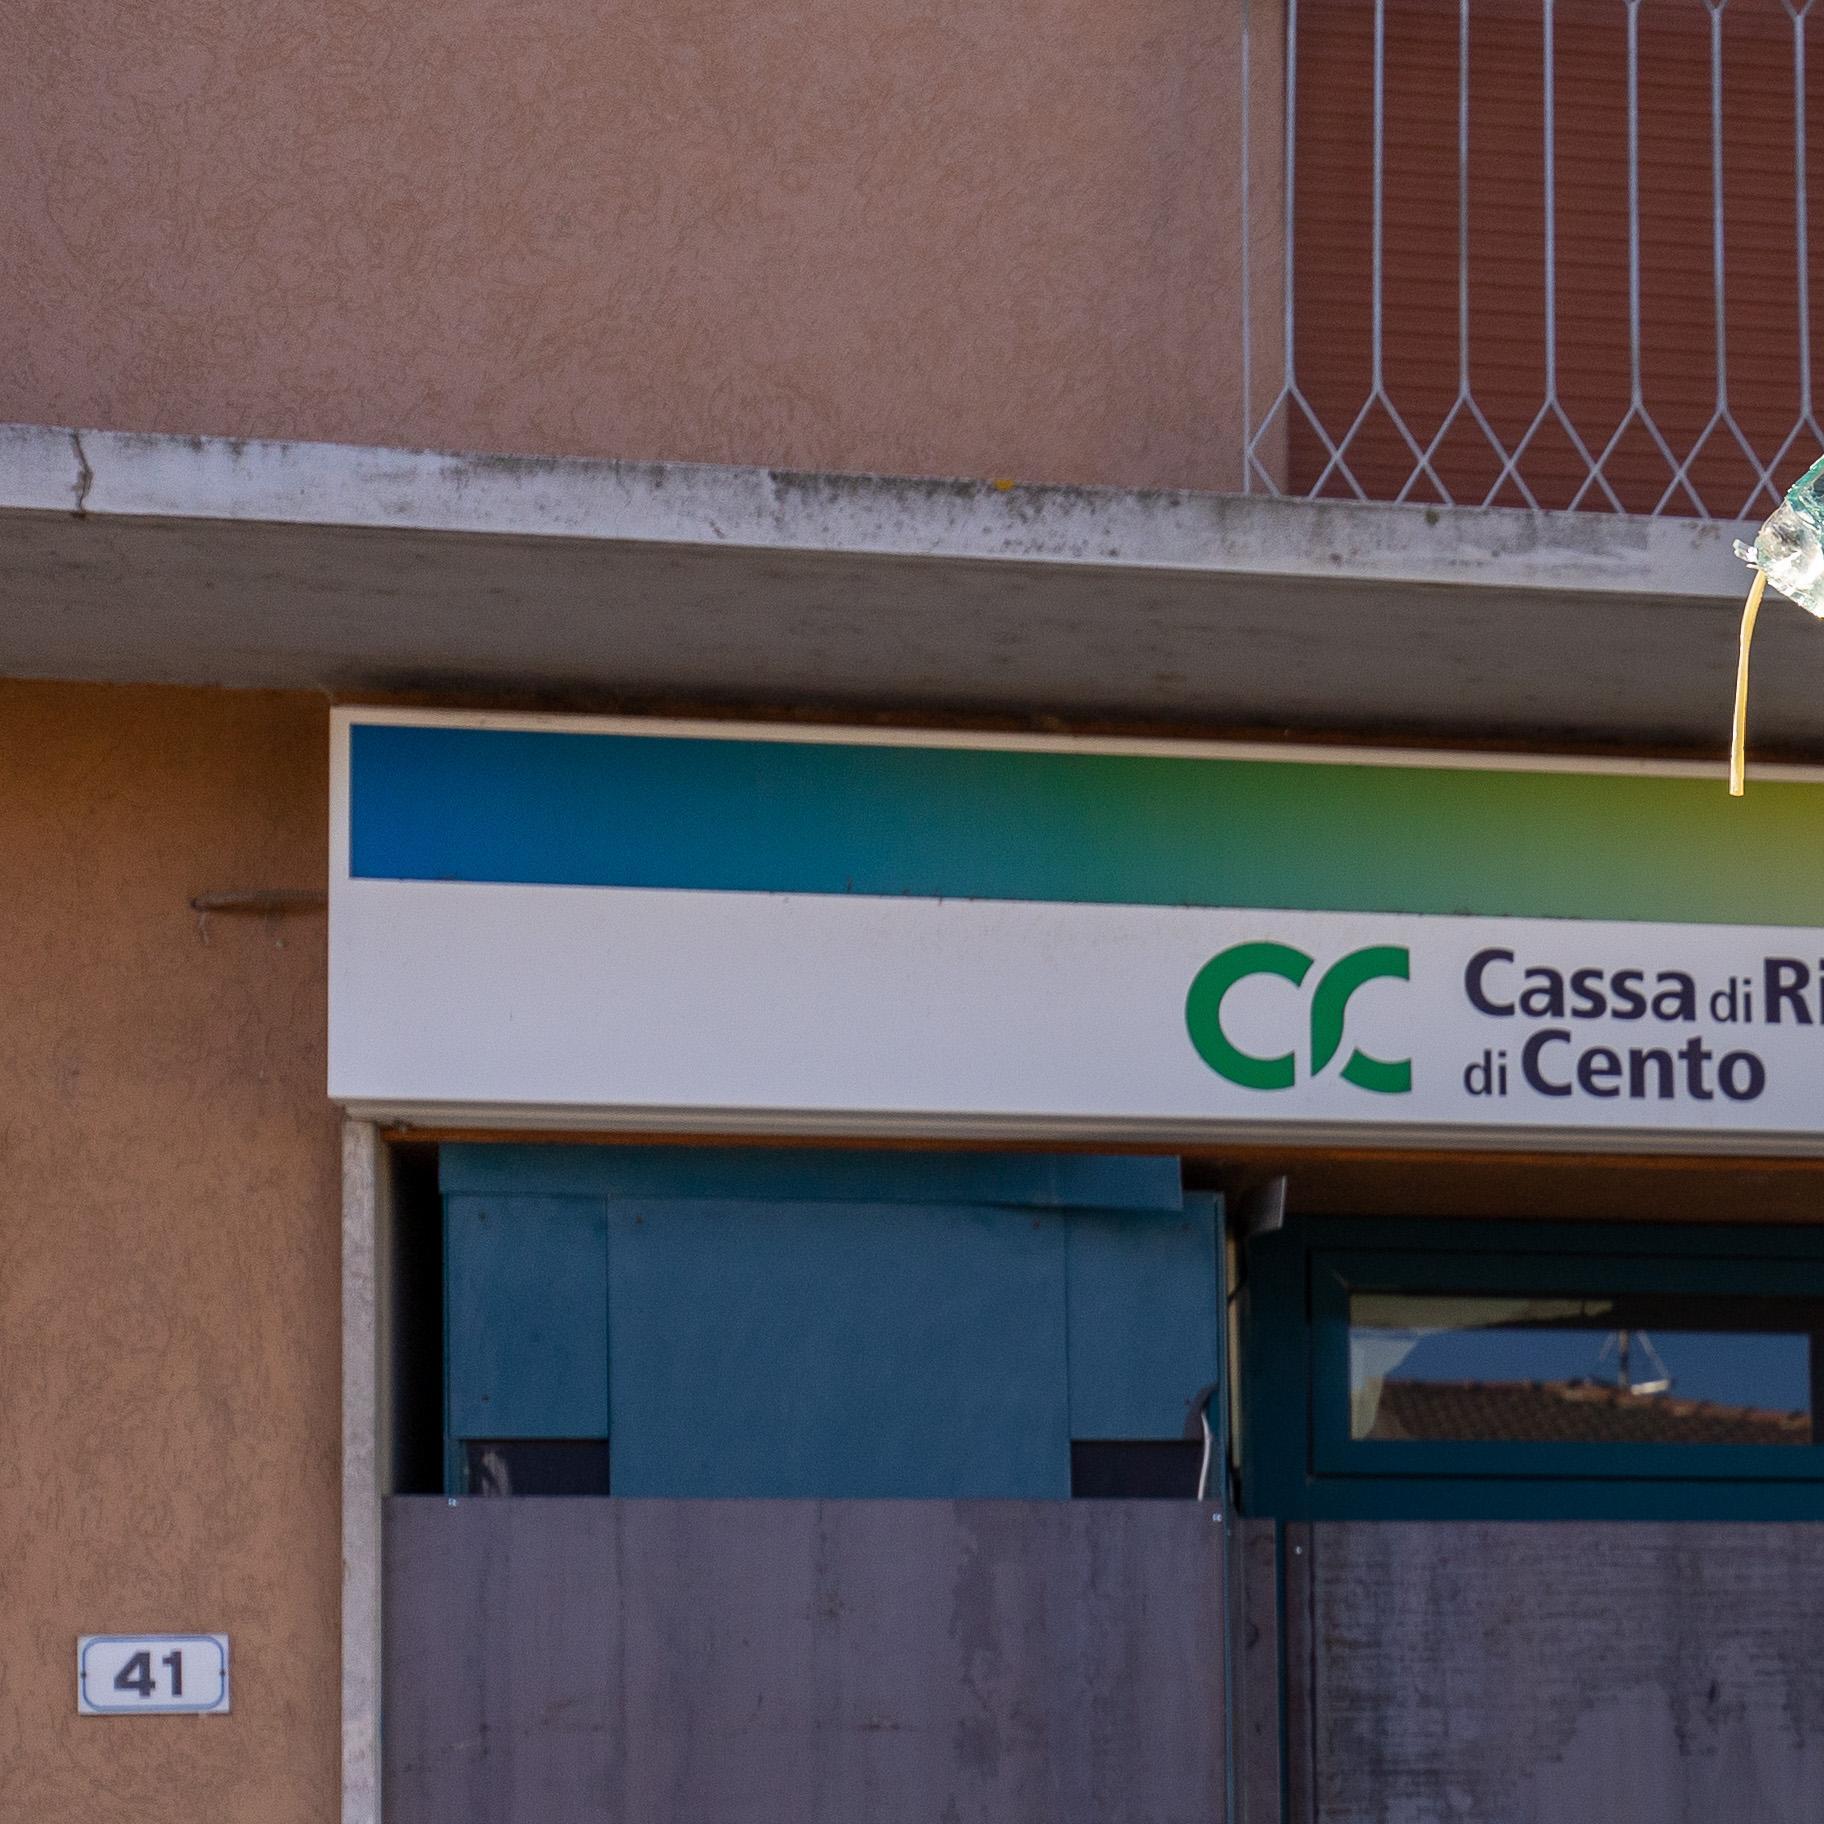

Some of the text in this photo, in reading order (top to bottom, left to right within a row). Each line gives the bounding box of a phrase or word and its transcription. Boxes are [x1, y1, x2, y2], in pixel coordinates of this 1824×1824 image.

[1464, 947, 1697, 1022] Cassa
[1709, 975, 1753, 1024] di
[1463, 1028, 1767, 1102] di Cento
[113, 1650, 183, 1698] 41
